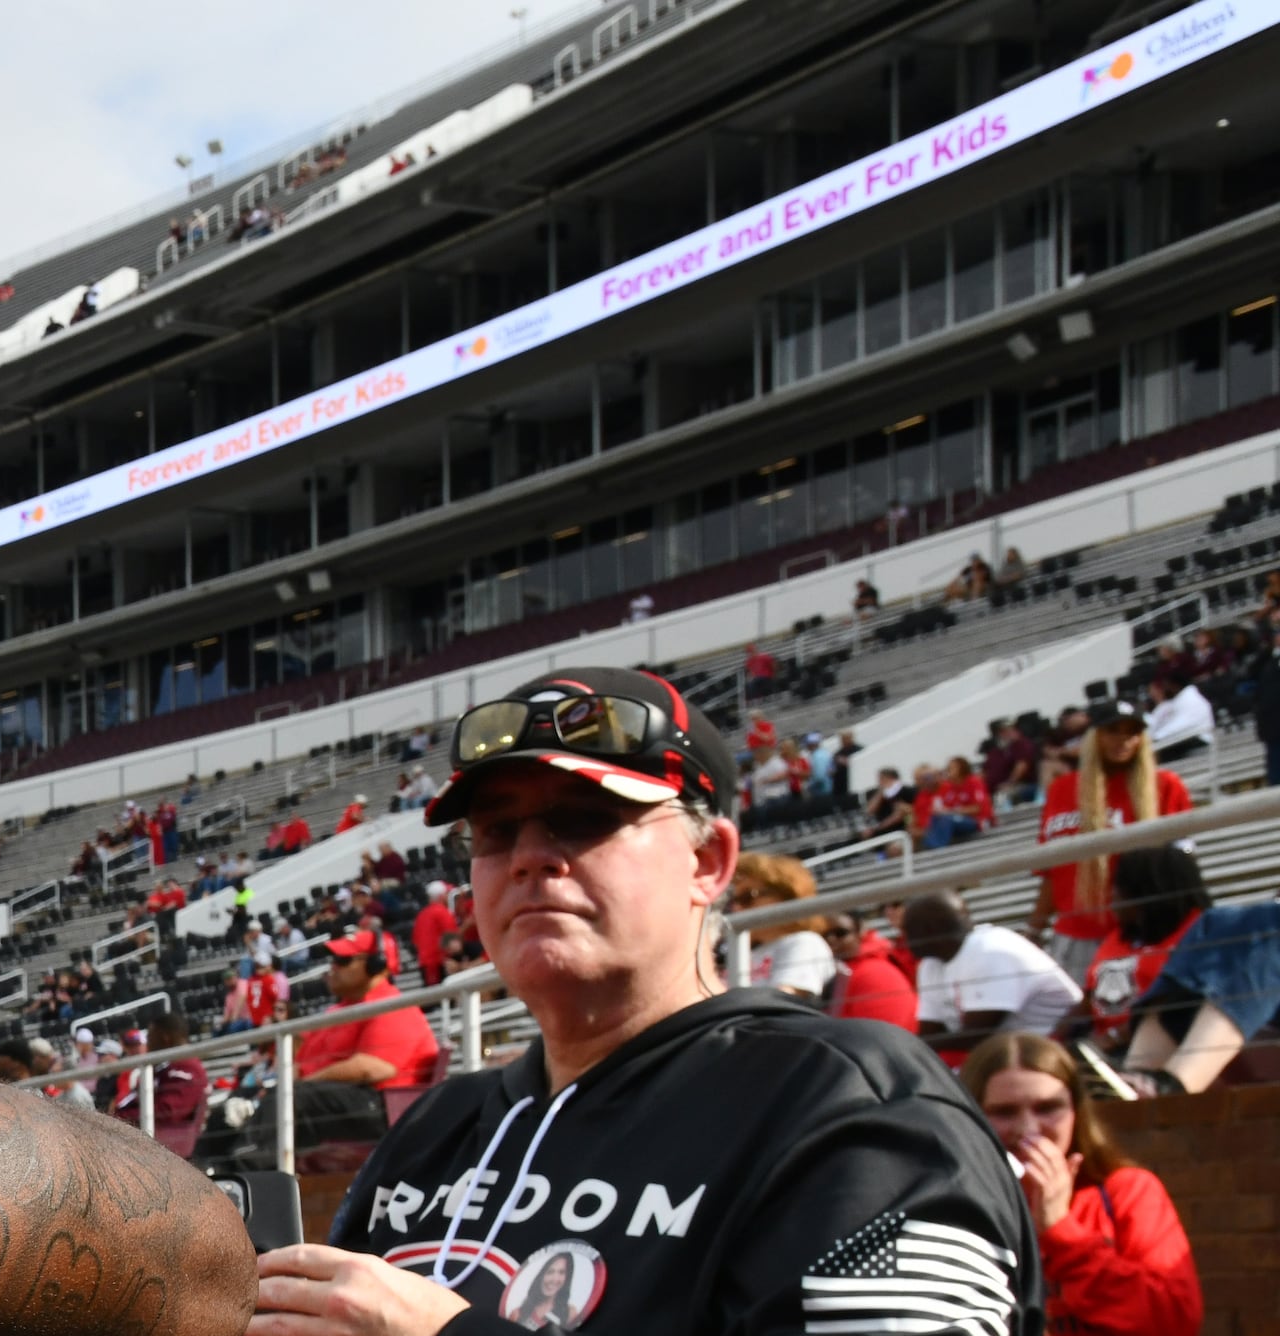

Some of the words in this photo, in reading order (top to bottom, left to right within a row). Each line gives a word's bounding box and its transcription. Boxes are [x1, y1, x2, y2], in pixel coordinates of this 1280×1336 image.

[601, 243, 709, 309] Forever
[717, 213, 773, 258] and
[783, 180, 856, 231] Ever
[864, 151, 921, 196] For
[930, 112, 1009, 171] Kids
[127, 449, 206, 492] Forever
[212, 430, 251, 462] and
[257, 410, 306, 445] Ever
[311, 393, 349, 424] For
[355, 371, 406, 407] Kids
